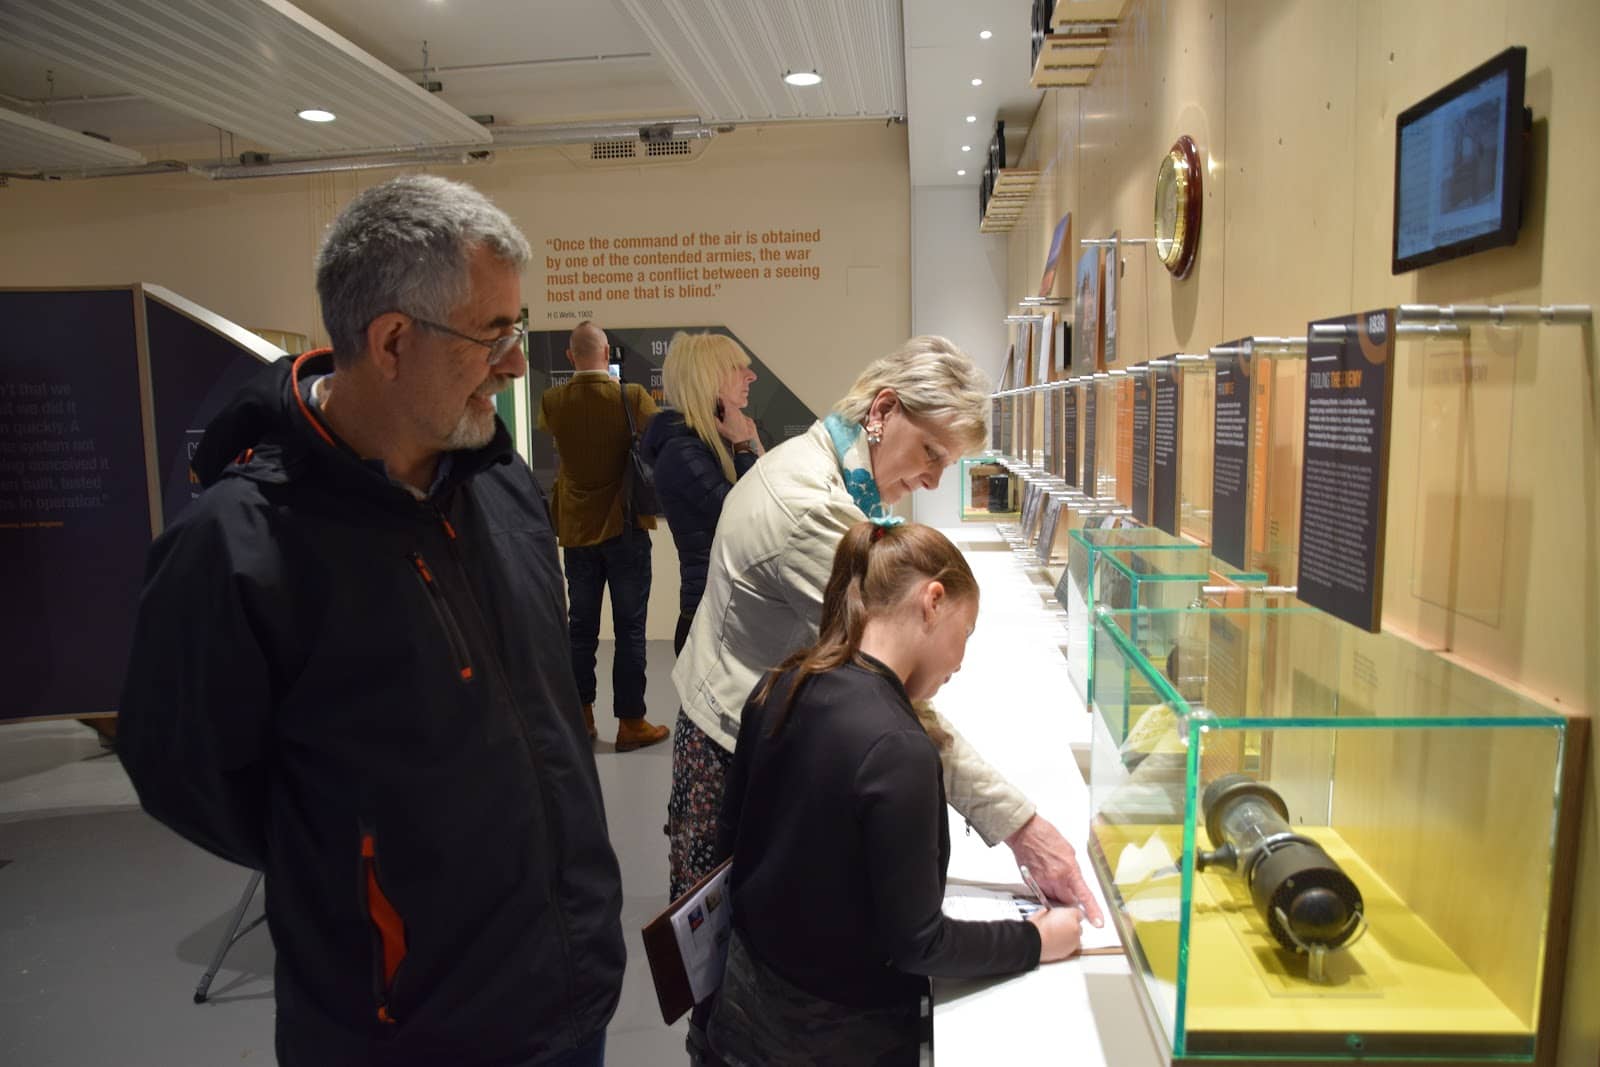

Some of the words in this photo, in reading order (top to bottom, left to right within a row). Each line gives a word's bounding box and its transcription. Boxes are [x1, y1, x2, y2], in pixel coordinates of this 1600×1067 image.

[589, 236, 610, 250] the
[613, 233, 679, 250] command
[682, 232, 696, 247] of
[699, 232, 720, 247] the
[723, 230, 743, 246] air
[746, 230, 759, 246] is
[761, 228, 821, 245] obtained
[546, 254, 562, 271] by
[565, 256, 588, 268] one
[592, 252, 606, 268] of
[609, 252, 630, 267] the
[633, 249, 703, 266] contended
[706, 248, 756, 264] armies,
[759, 246, 782, 262] the
[785, 248, 811, 261] war
[546, 272, 580, 286] must
[583, 270, 633, 285] become
[637, 271, 645, 283] a
[649, 266, 699, 282] conflict
[702, 265, 760, 281] between
[763, 267, 771, 280] a
[776, 262, 821, 280] seeing
[547, 287, 575, 303] host
[579, 286, 602, 301] and
[606, 288, 630, 300] one
[634, 284, 660, 300] that
[664, 284, 675, 298] is
[50, 384, 72, 396] we
[70, 420, 81, 433] A
